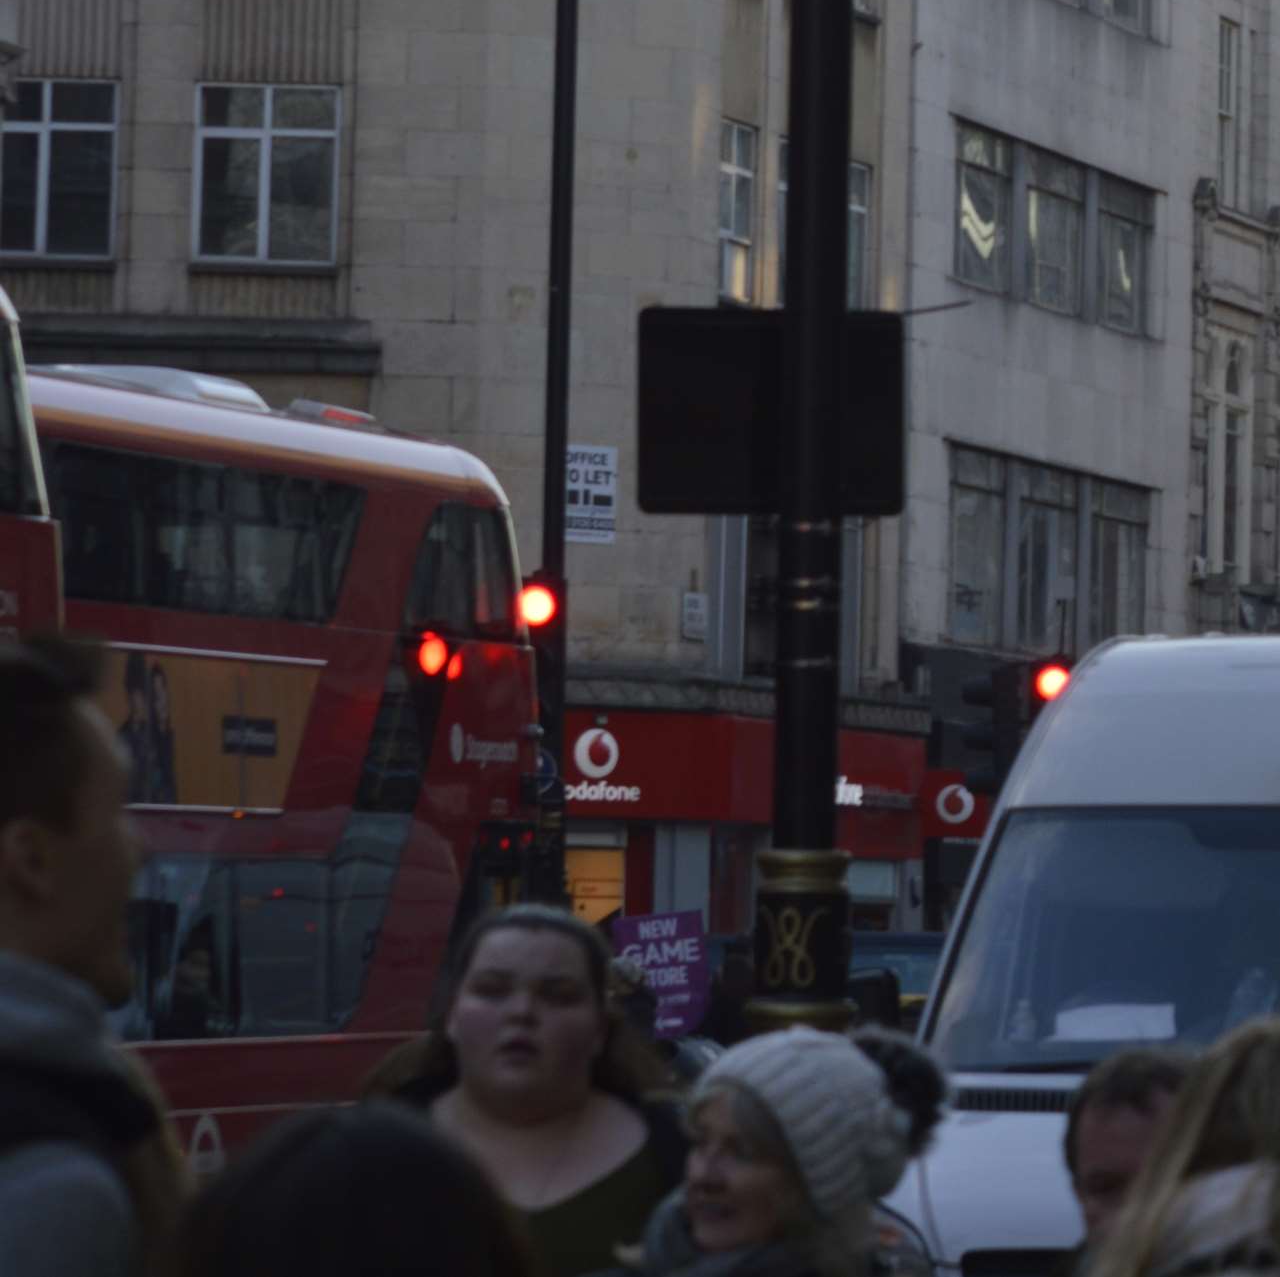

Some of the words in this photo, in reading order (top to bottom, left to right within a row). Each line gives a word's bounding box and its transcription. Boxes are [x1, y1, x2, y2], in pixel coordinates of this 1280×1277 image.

[584, 469, 612, 485] LET
[564, 780, 640, 802] odafone
[638, 917, 677, 940] NEW
[622, 937, 701, 965] GAME
[647, 965, 688, 988] TORE
